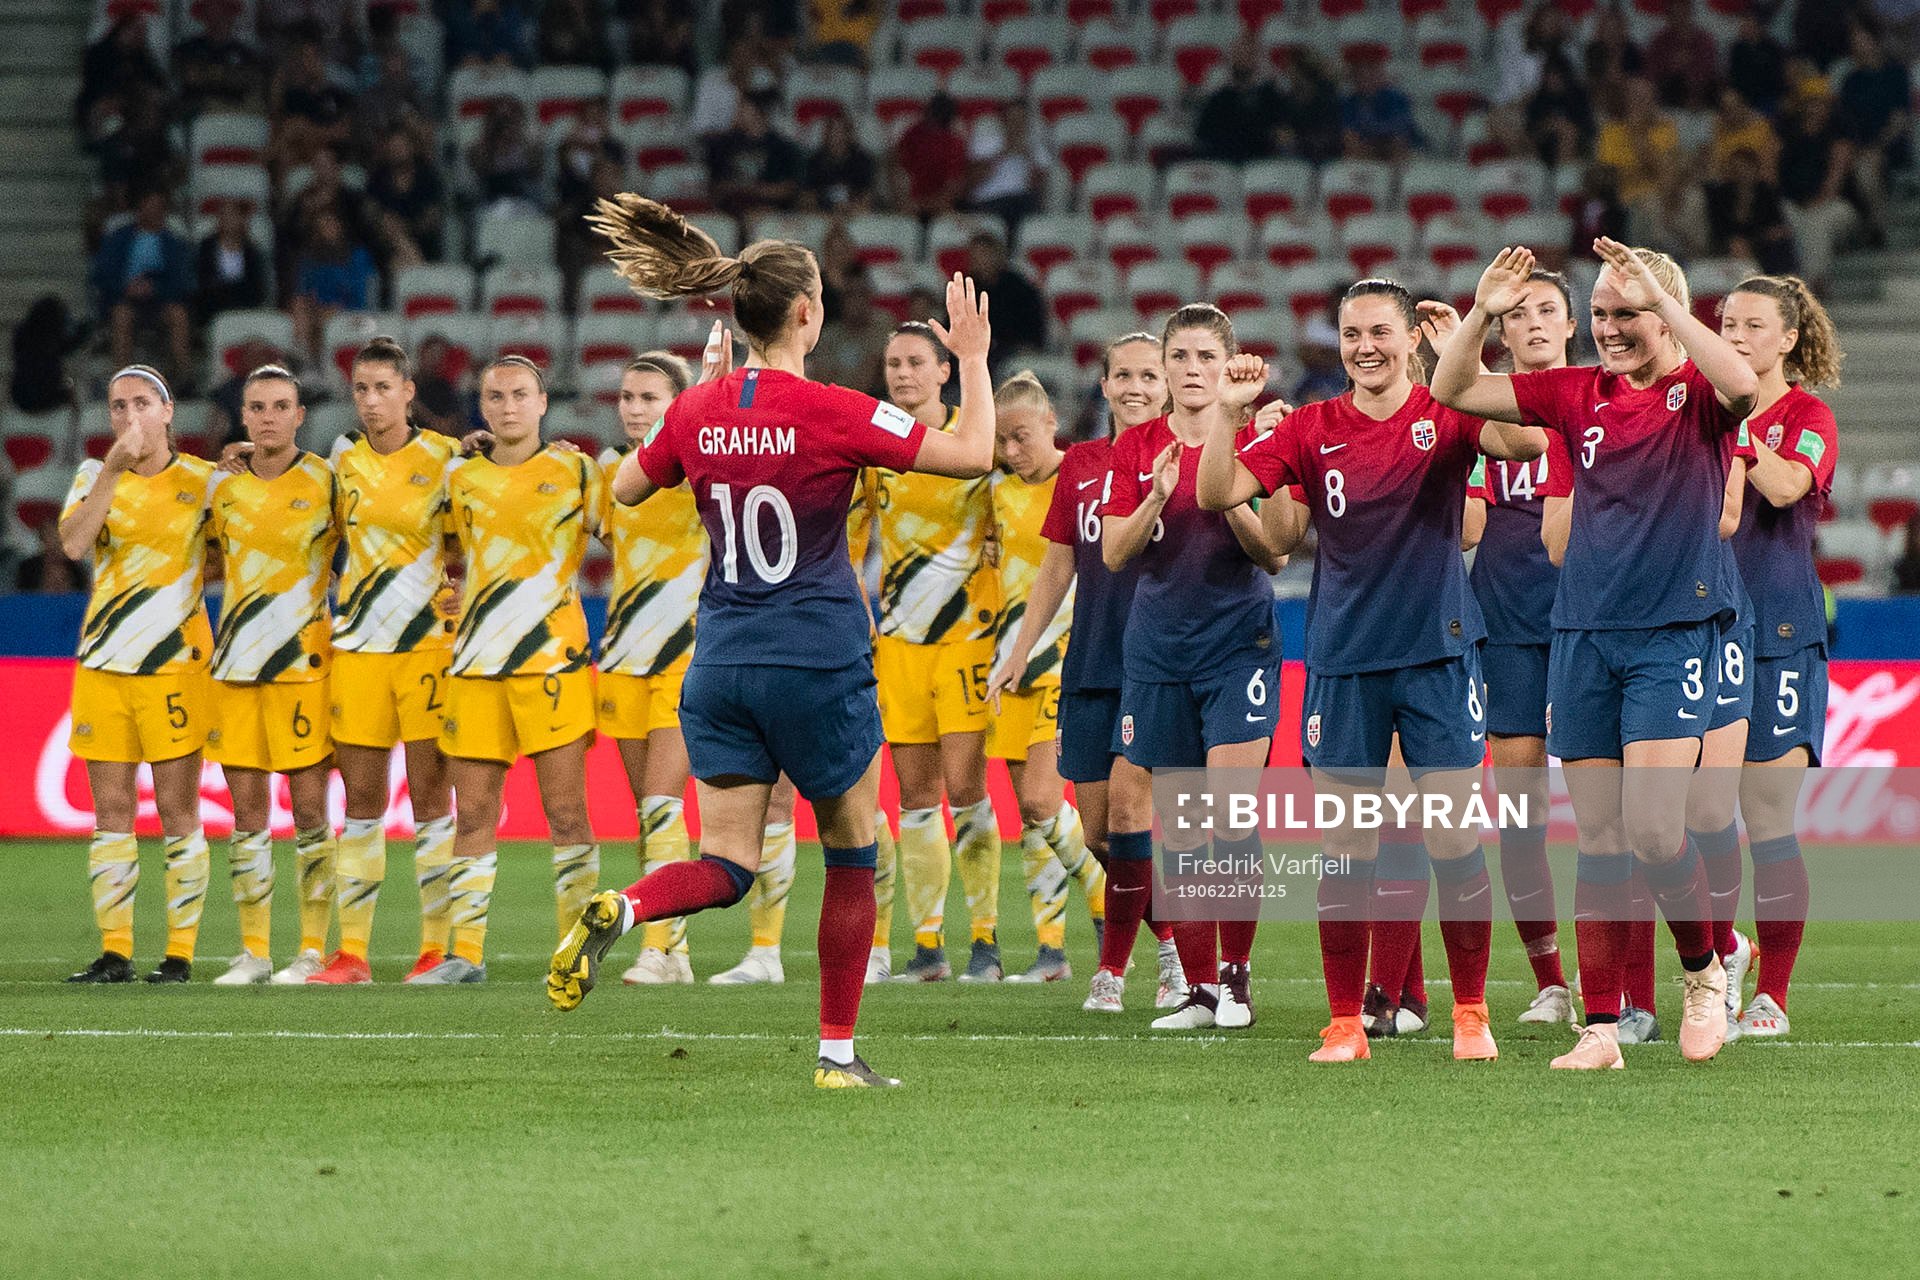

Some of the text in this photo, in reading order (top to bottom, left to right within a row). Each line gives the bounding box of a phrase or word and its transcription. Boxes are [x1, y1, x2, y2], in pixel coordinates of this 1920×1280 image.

[698, 426, 796, 455] GRAHAM
[1581, 426, 1605, 469] 3
[1325, 469, 1347, 518] 8
[1496, 460, 1536, 501] 14
[710, 483, 798, 584] 10
[1078, 499, 1101, 543] 16
[543, 674, 561, 711] 9
[957, 663, 989, 704] 15
[1247, 668, 1266, 706] 6
[1468, 676, 1483, 722] 8
[1682, 658, 1705, 701] 3
[1777, 670, 1799, 717] 5
[166, 692, 188, 729] 5
[293, 700, 311, 738] 6
